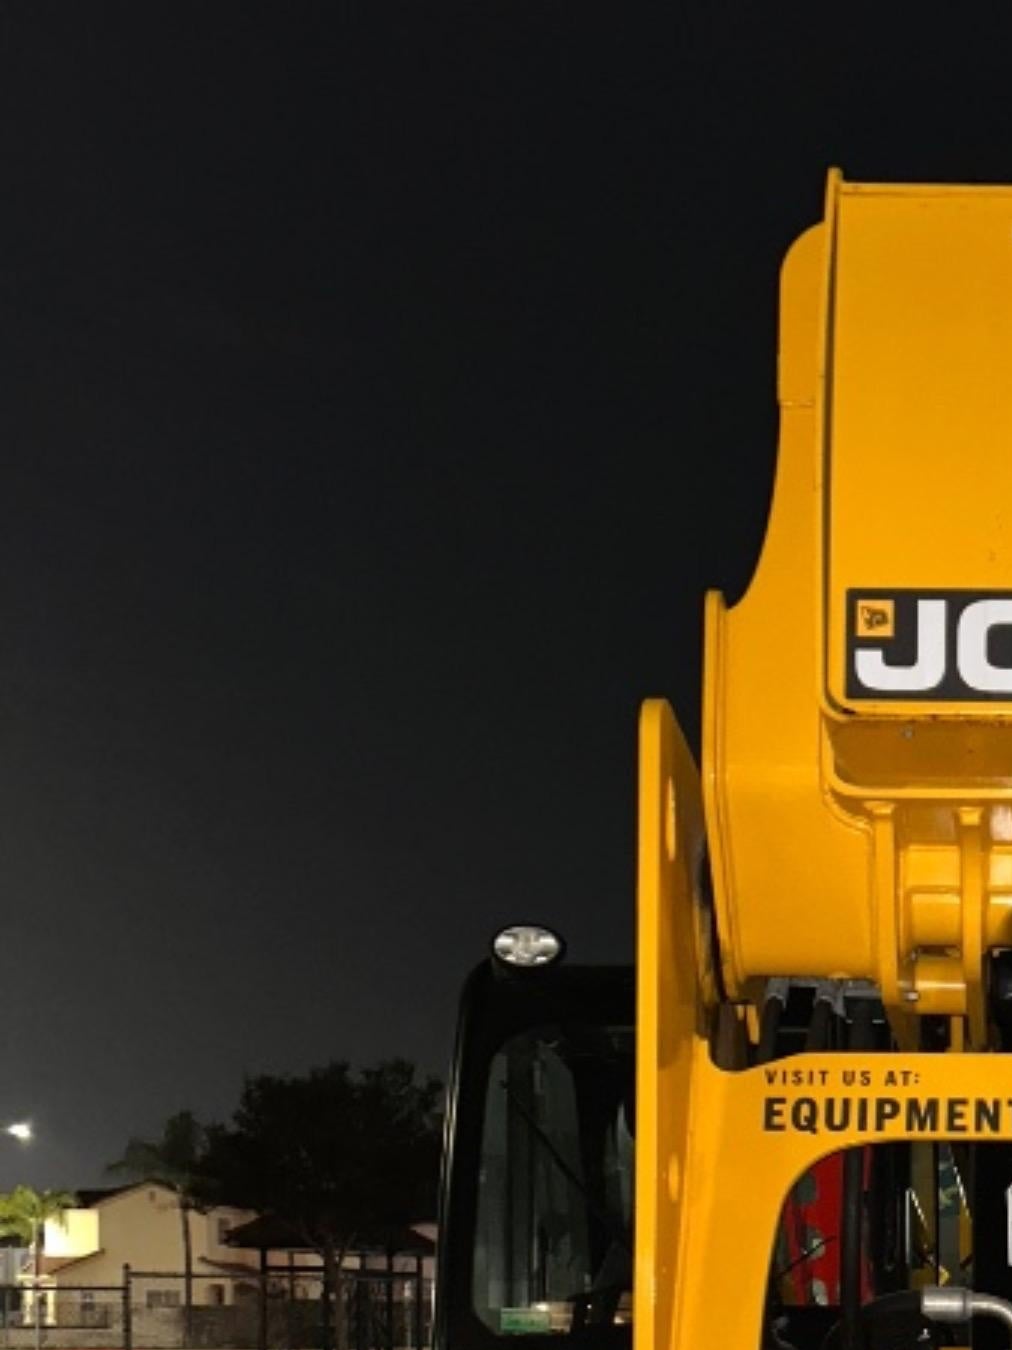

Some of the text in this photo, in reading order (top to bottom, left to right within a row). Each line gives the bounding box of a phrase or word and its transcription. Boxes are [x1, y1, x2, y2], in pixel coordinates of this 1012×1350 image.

[764, 1069, 921, 1087] VISIT US AT:
